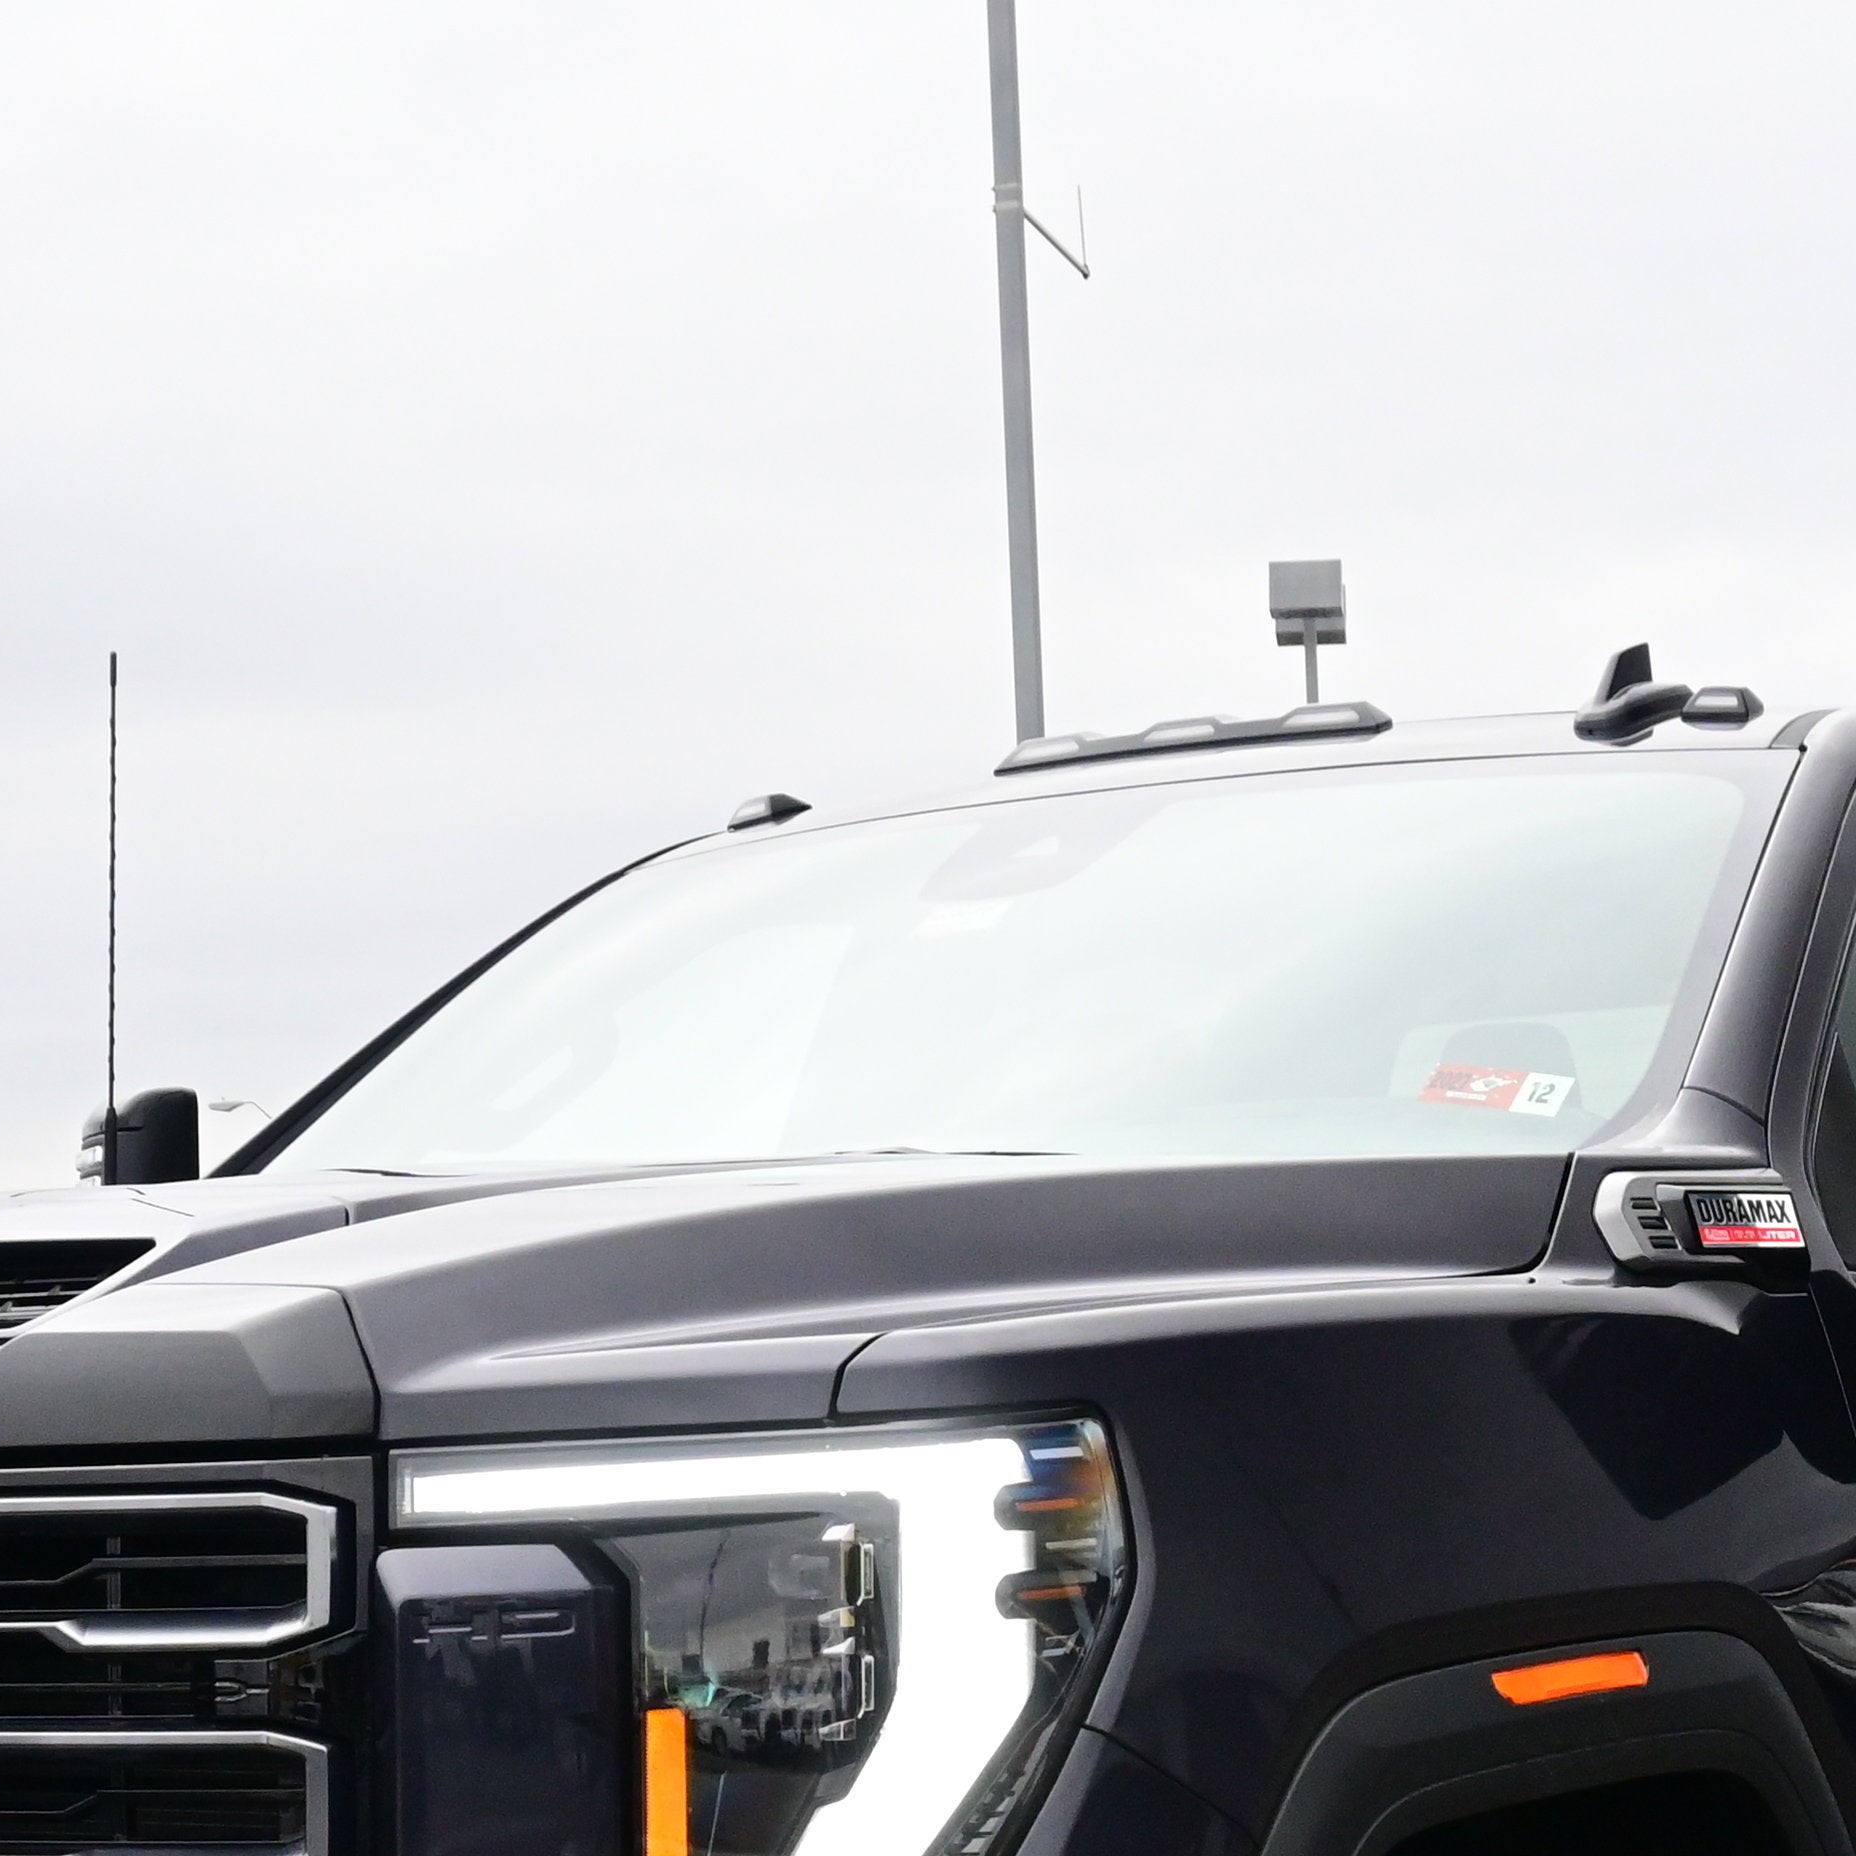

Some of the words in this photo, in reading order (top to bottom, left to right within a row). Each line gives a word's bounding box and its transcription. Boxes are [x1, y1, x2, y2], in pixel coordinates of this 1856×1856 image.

[1527, 1081, 1555, 1104] 12
[1696, 1199, 1791, 1224] DURAMAX
[1758, 1229, 1795, 1240] LITER
